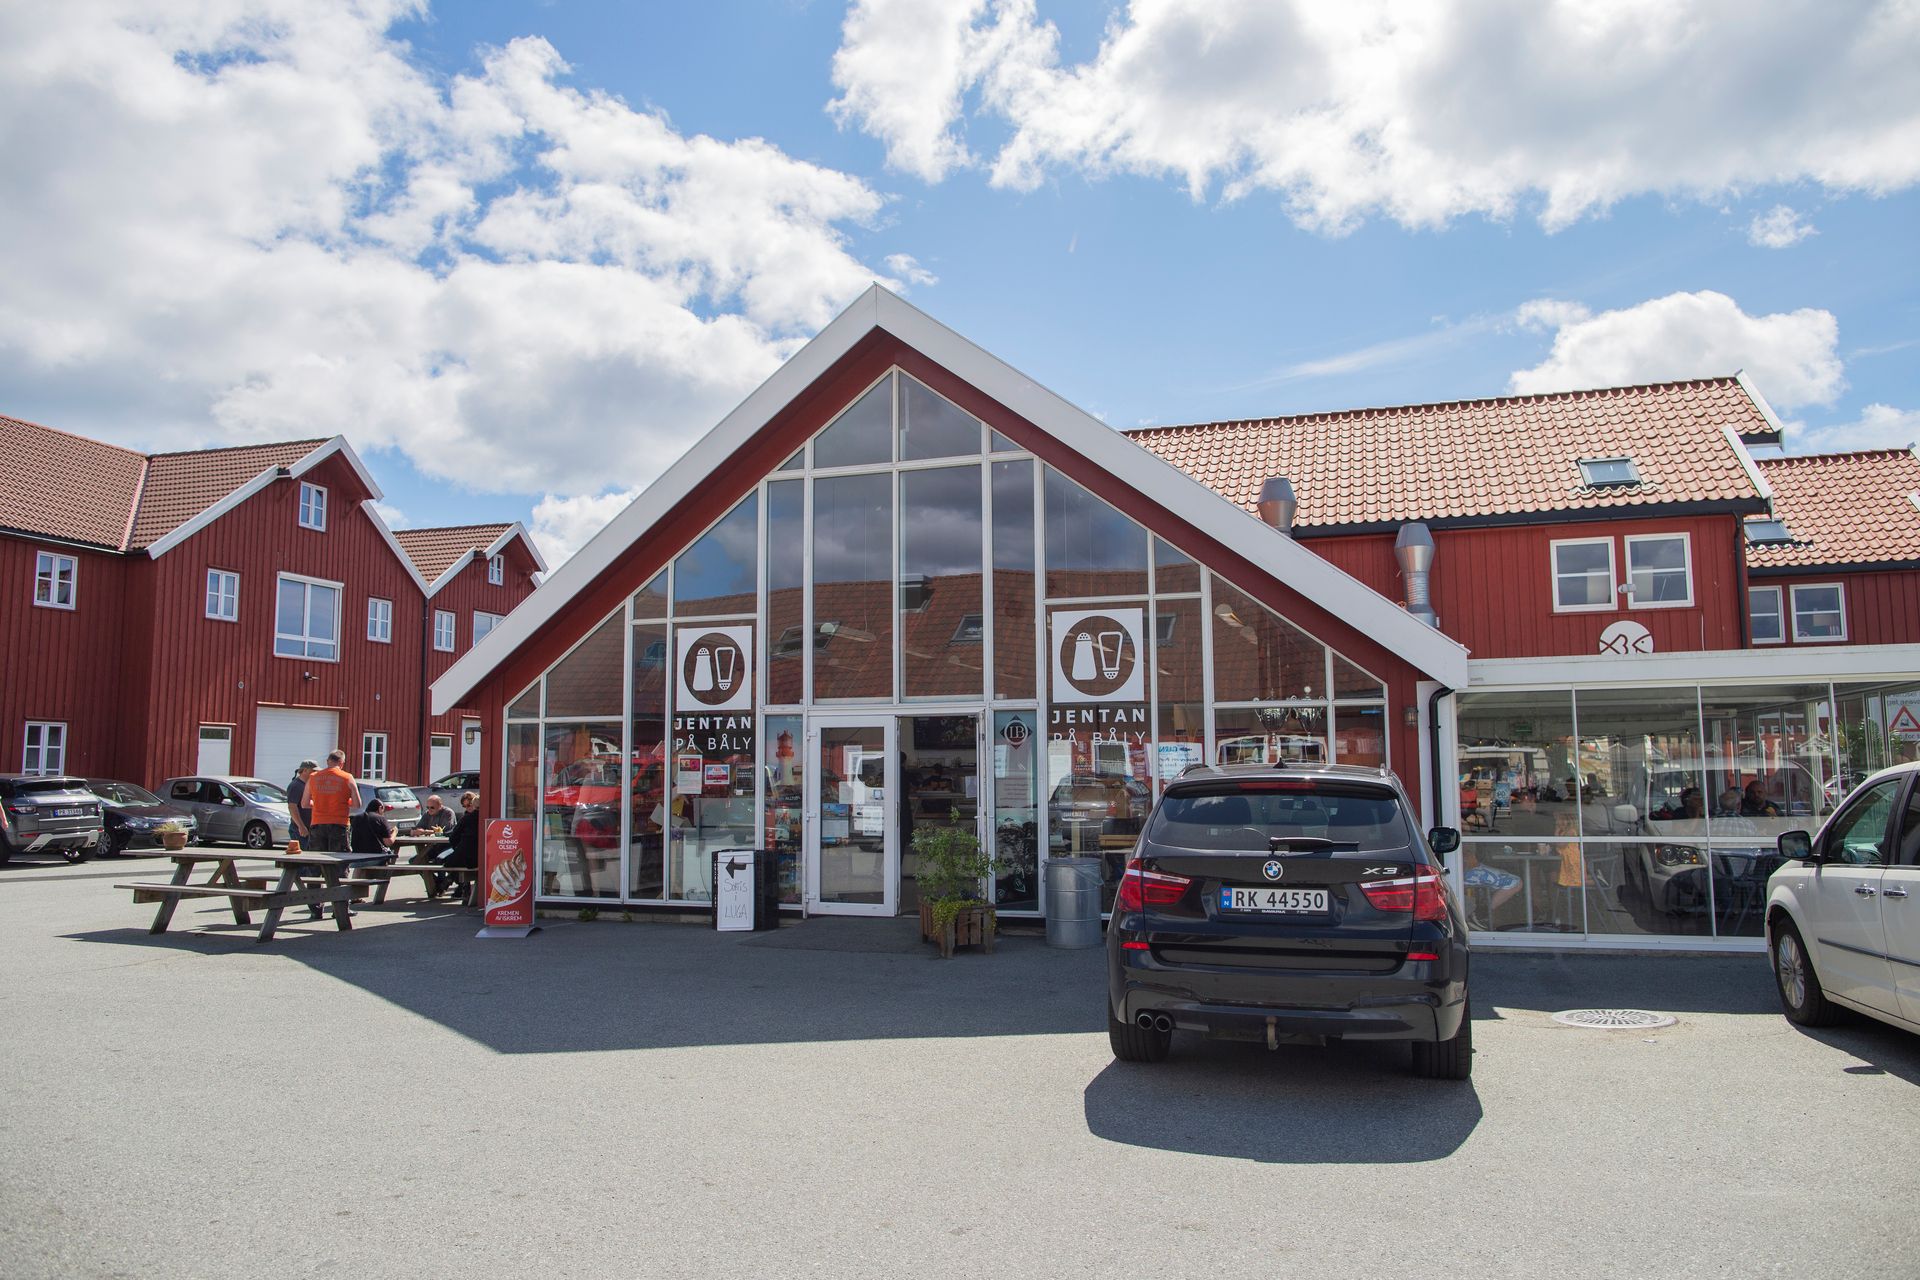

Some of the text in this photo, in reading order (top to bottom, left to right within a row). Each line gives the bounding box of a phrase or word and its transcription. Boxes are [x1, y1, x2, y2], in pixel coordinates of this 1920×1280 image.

[674, 716, 752, 730] JENTAN
[1052, 708, 1145, 724] JENTAN
[676, 733, 752, 750] PÅ BÅLY
[1053, 727, 1146, 746] PÅ BÅLY
[1362, 867, 1398, 875] X3
[1235, 891, 1324, 909] RK 44550
